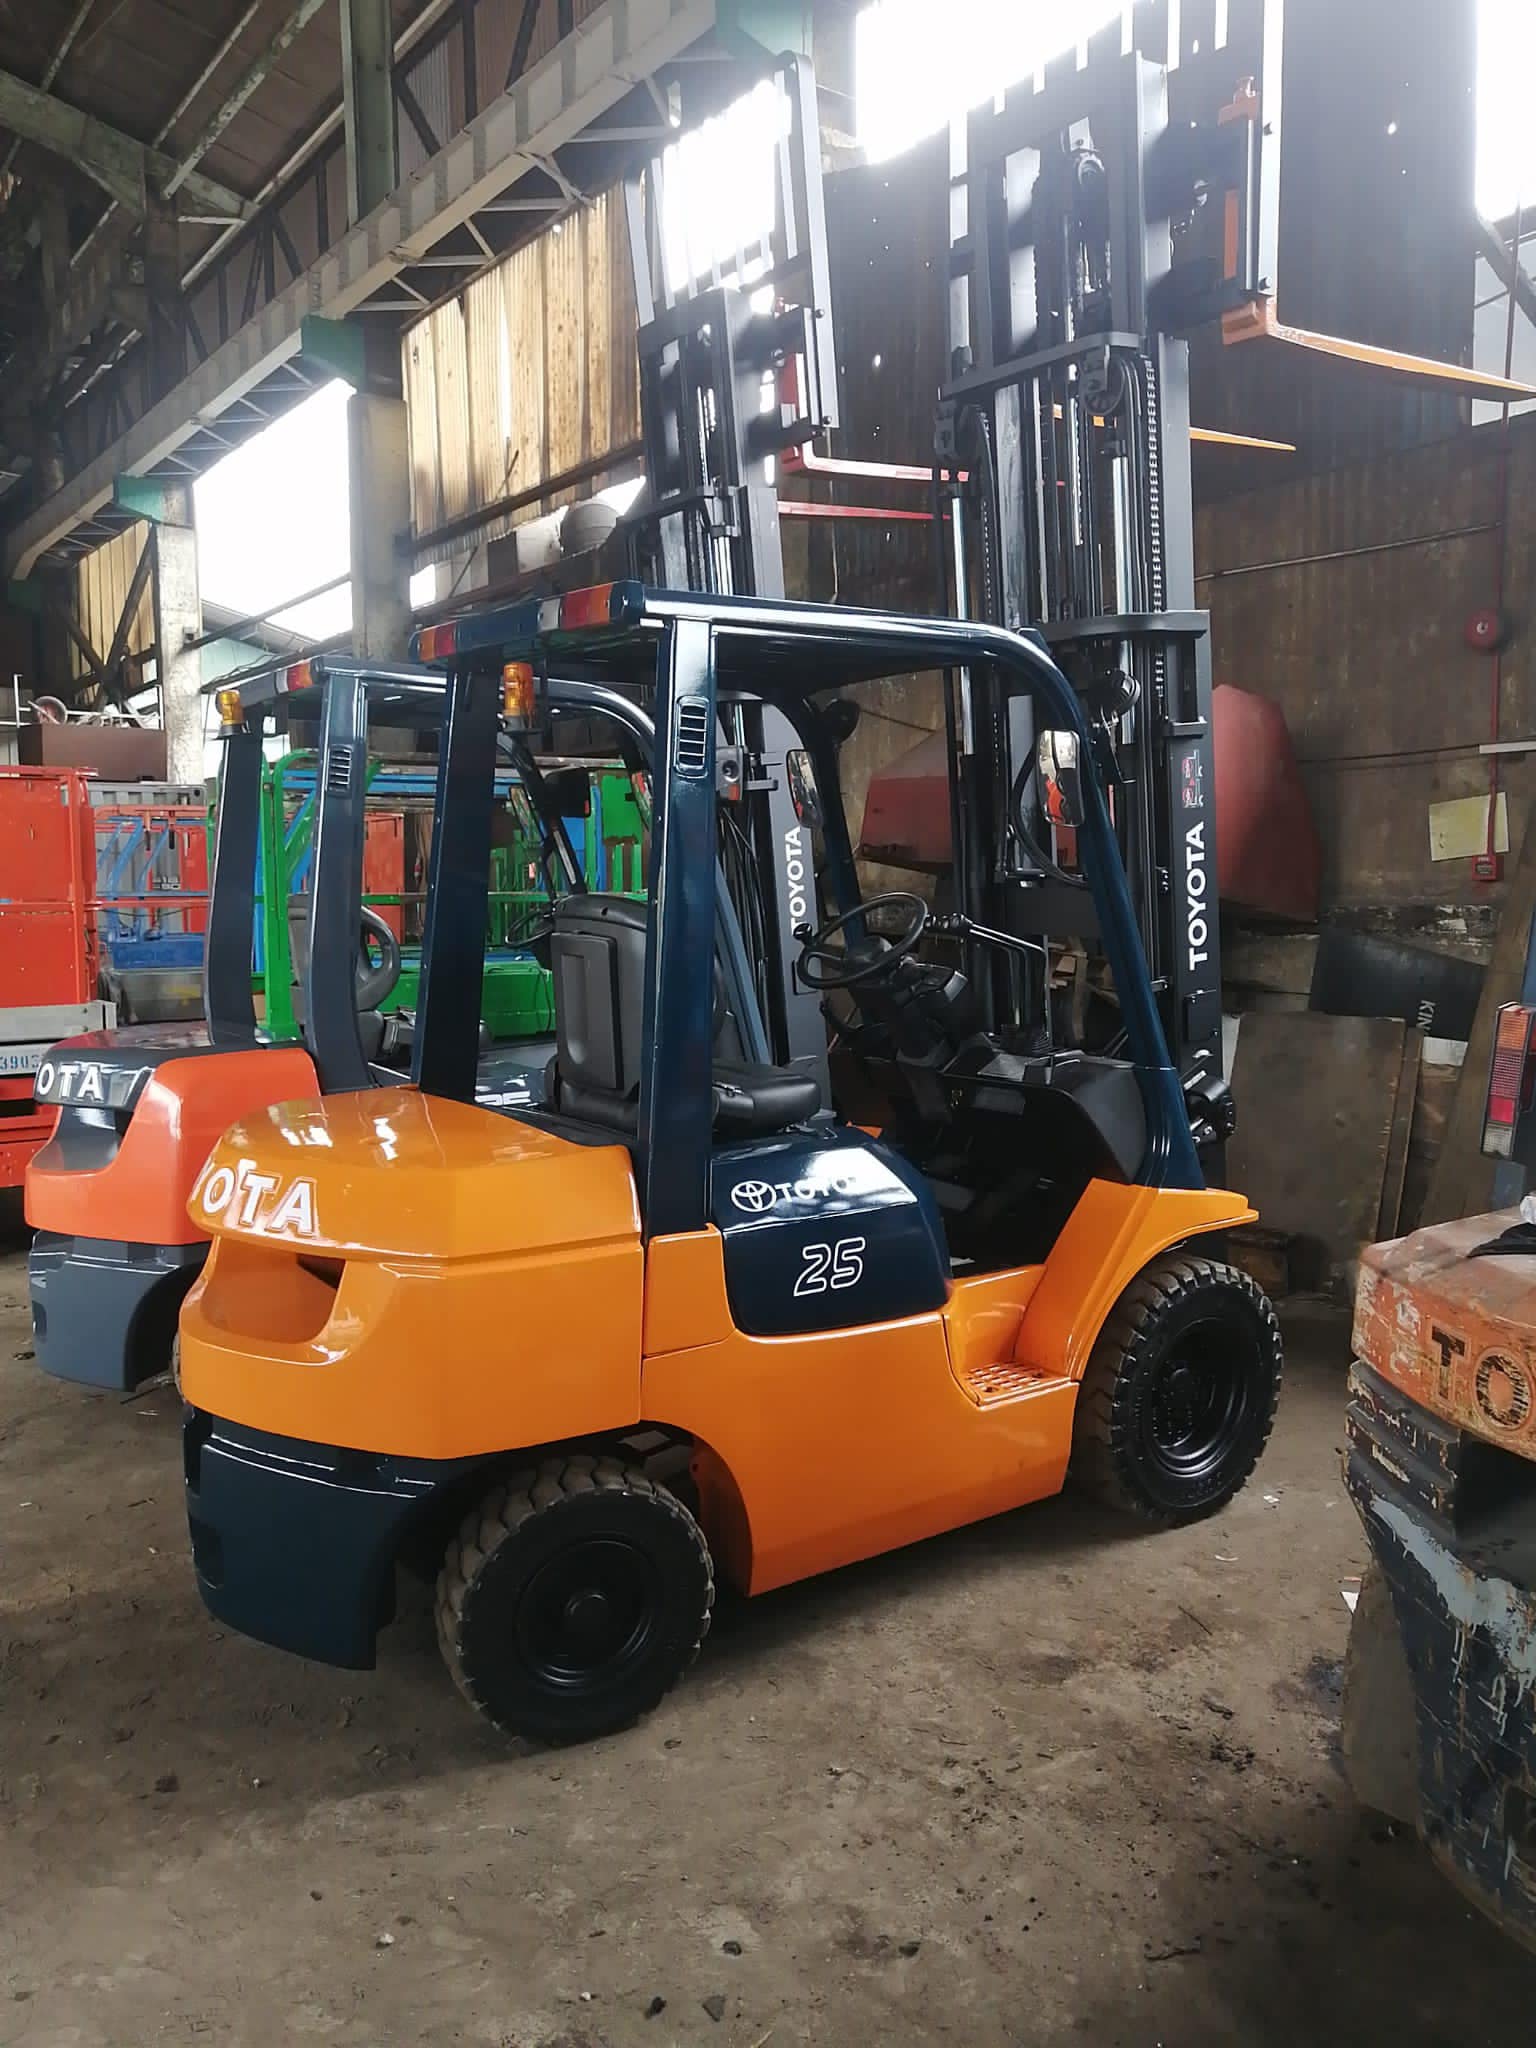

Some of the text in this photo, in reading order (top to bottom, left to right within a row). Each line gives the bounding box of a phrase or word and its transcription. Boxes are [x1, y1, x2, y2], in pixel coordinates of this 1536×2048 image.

[1186, 821, 1208, 971] TOYOTA
[1416, 1000, 1436, 1036] KIN
[191, 1158, 317, 1238] OTA
[775, 1176, 857, 1203] TOYO
[793, 1236, 866, 1297] 25
[1430, 1325, 1530, 1428] TO
